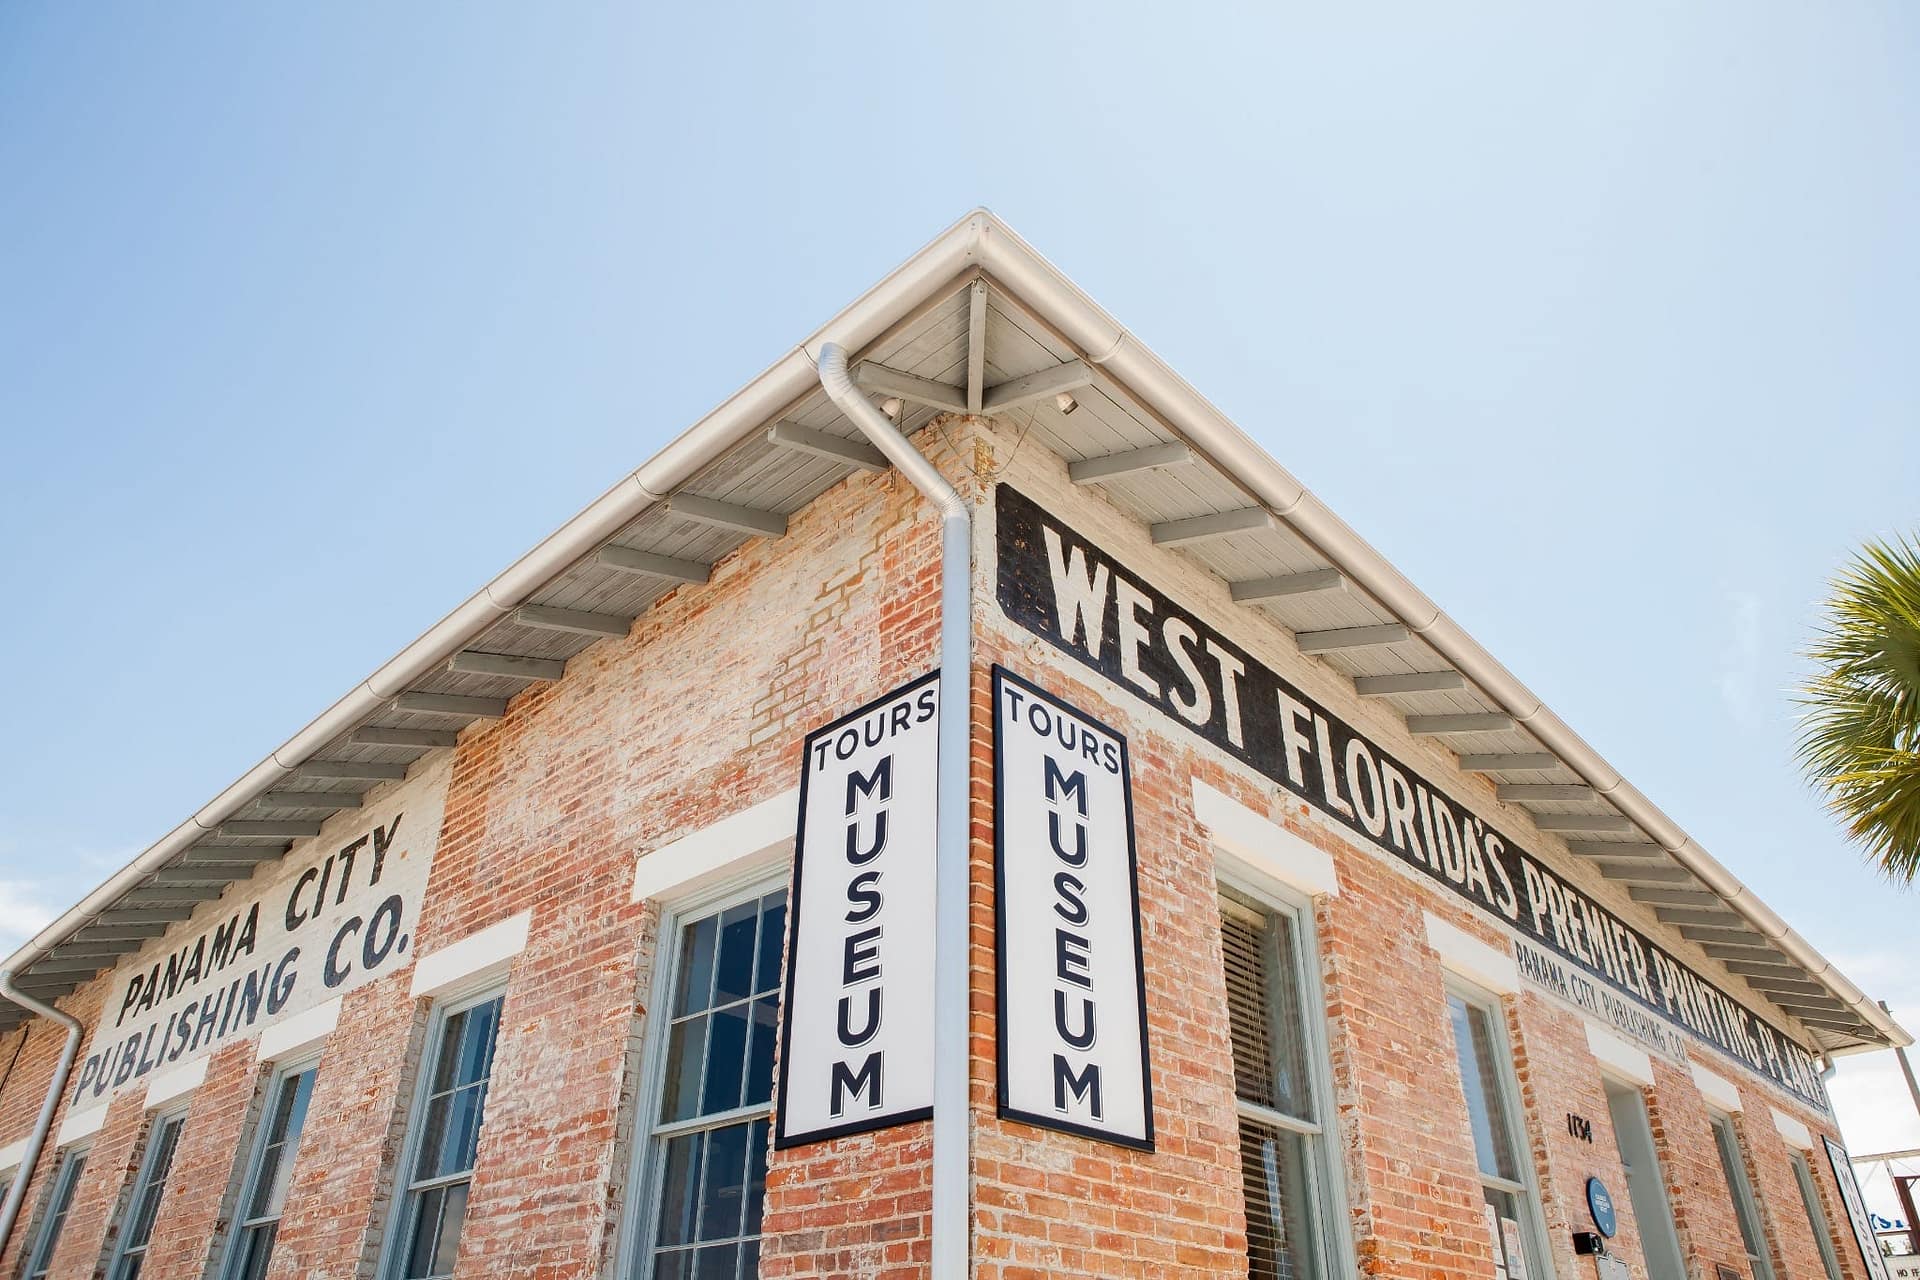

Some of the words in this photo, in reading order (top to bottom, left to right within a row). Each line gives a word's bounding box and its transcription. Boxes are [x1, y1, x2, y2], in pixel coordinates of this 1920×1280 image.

[814, 688, 936, 772] TOURS
[1003, 686, 1121, 776] TOURS
[1042, 523, 1246, 753] WEST
[1277, 687, 1519, 921] FLORIDA'S
[1520, 856, 1658, 1006] PREMIER
[1651, 947, 1763, 1070] PRINTING
[1755, 1019, 1825, 1107] PLANT
[71, 946, 301, 1107] PUBLISHING
[323, 893, 409, 989] CO.
[116, 901, 261, 1028] PANAMA
[285, 812, 404, 932] CITY
[830, 753, 893, 1120] MUSEUM
[1043, 754, 1104, 1122] MUSEUM
[1515, 940, 1570, 999] PANAMA
[1571, 974, 1599, 1013] CITY
[1601, 990, 1667, 1051] PUBLISHING
[1567, 1113, 1593, 1144] 1134
